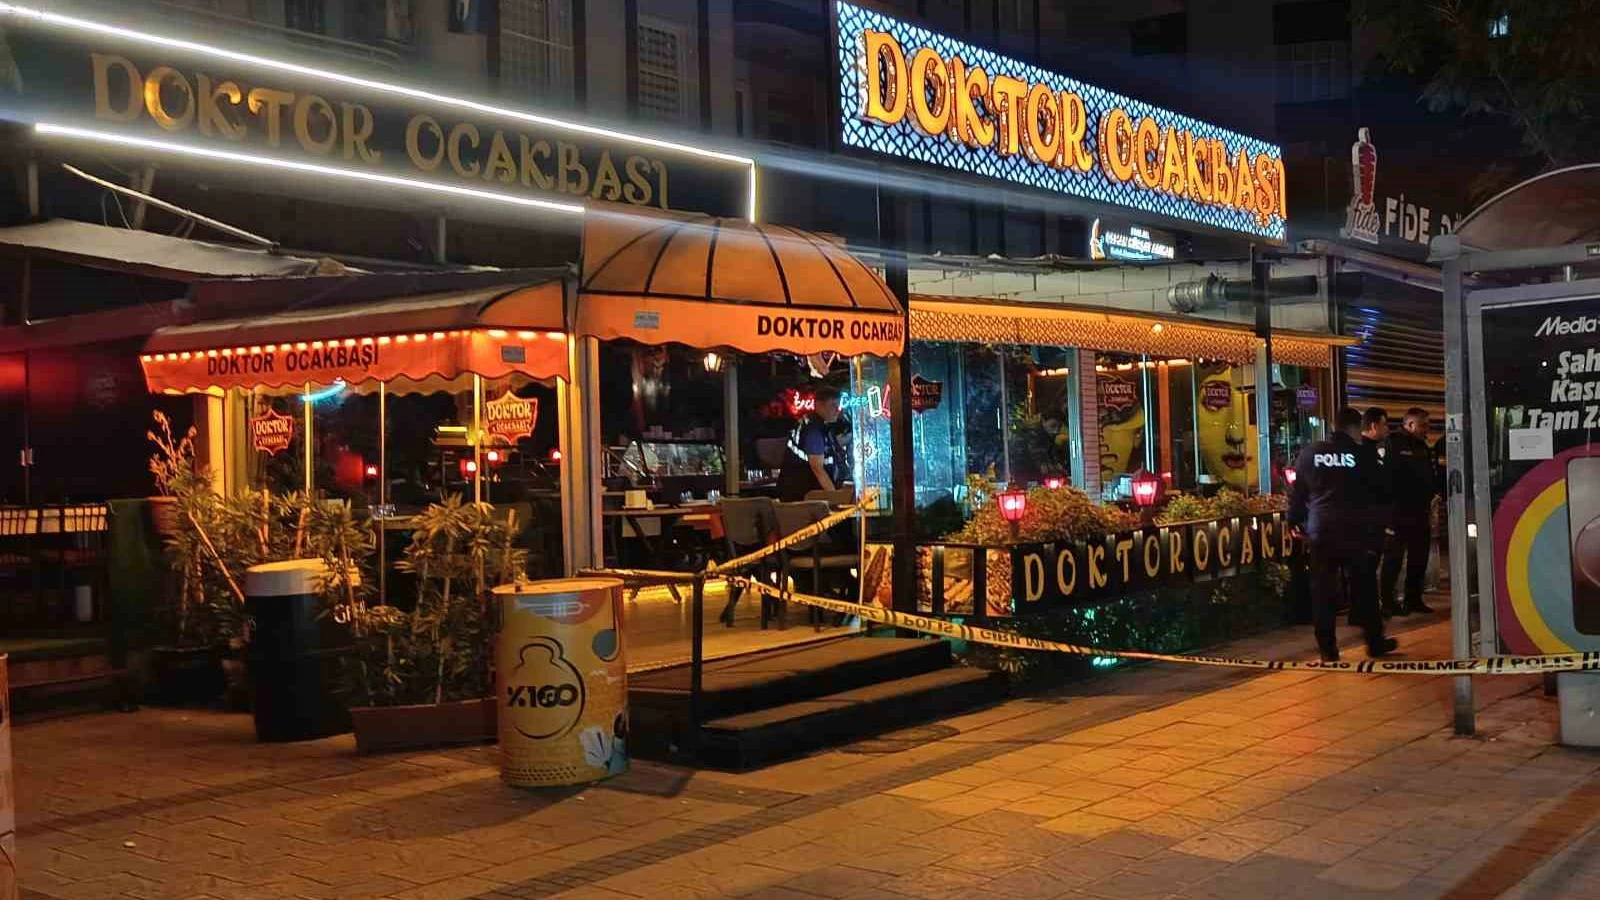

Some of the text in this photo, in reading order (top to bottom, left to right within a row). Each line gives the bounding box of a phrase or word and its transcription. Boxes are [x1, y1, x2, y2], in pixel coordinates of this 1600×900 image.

[91, 53, 382, 163] DOKTOR
[862, 28, 1288, 227] DOKTOR OCAKBAŞI
[757, 315, 844, 340] DOKTOR
[1534, 315, 1597, 337] Media
[207, 344, 379, 376] DOKTOR OCAKBAŞI
[488, 401, 531, 420] DOKTOR
[1527, 405, 1600, 431] Tam Z
[255, 420, 289, 435] DOKTOR
[1314, 453, 1356, 468] POLIS
